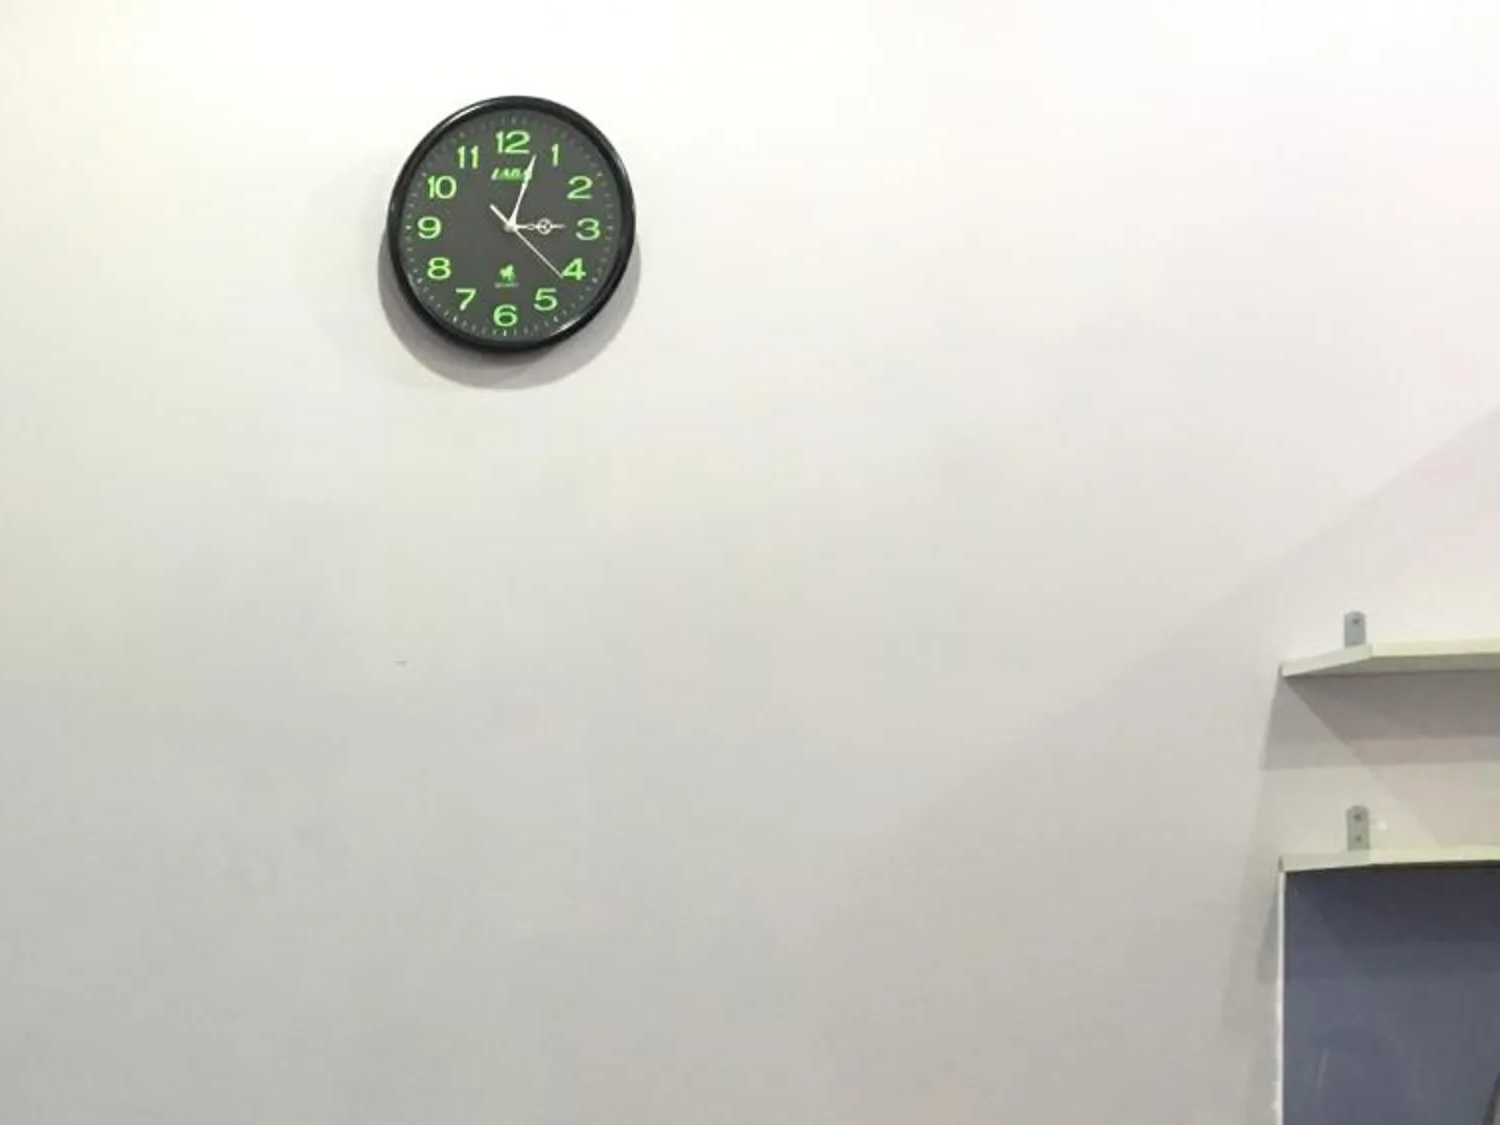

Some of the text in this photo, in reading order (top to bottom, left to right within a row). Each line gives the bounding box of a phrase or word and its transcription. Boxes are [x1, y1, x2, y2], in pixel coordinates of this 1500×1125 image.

[496, 130, 530, 154] 12
[458, 145, 478, 169] 11
[551, 144, 560, 166] 1
[427, 175, 457, 199] 10
[567, 176, 593, 199] 2
[418, 216, 441, 239] 9
[576, 218, 600, 240] 3
[427, 257, 451, 280] 8
[562, 258, 586, 280] 4
[456, 288, 476, 310] 7
[534, 288, 557, 311] 5
[493, 304, 518, 327] 6
